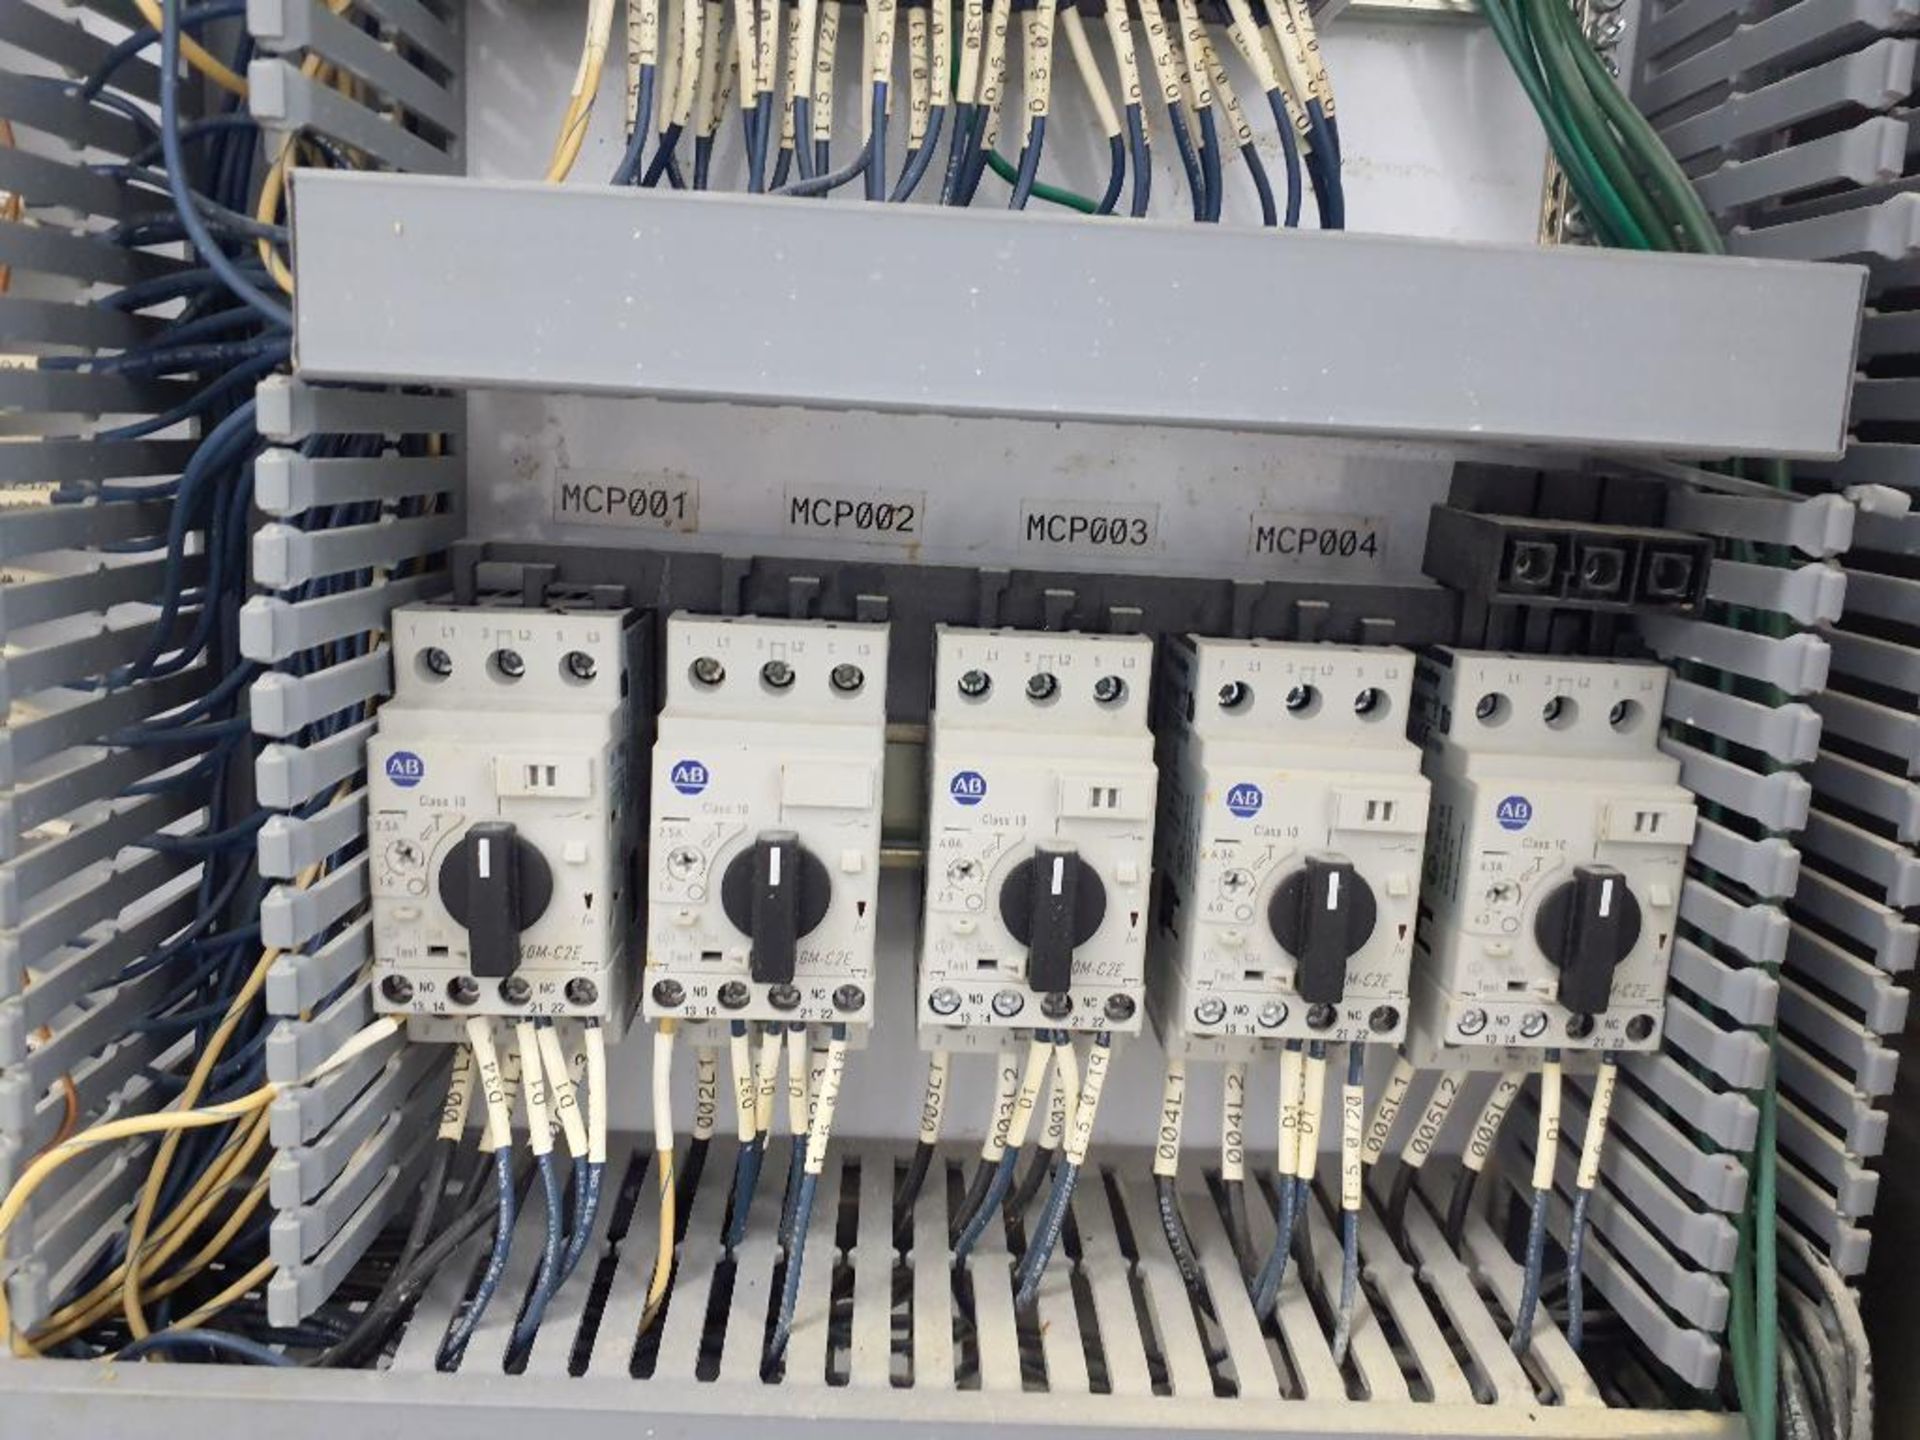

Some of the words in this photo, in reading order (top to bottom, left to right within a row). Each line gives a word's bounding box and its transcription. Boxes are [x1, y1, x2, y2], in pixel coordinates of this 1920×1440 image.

[561, 484, 687, 519] MCP001
[790, 497, 914, 532] MCP002
[1027, 514, 1149, 546] MCP003
[1256, 526, 1378, 559] MCP004
[420, 796, 448, 806] Class
[702, 803, 731, 814] Class
[982, 814, 1010, 825] Class
[1254, 825, 1282, 837] Class
[1523, 838, 1550, 849] Class
[697, 1060, 715, 1128] 002L1
[1159, 1074, 1183, 1160] 004L1
[1226, 1075, 1244, 1163] 004L2
[1367, 1076, 1408, 1153] 005L1
[1412, 1078, 1457, 1154] 005L2
[1472, 1081, 1517, 1157] 005L3
